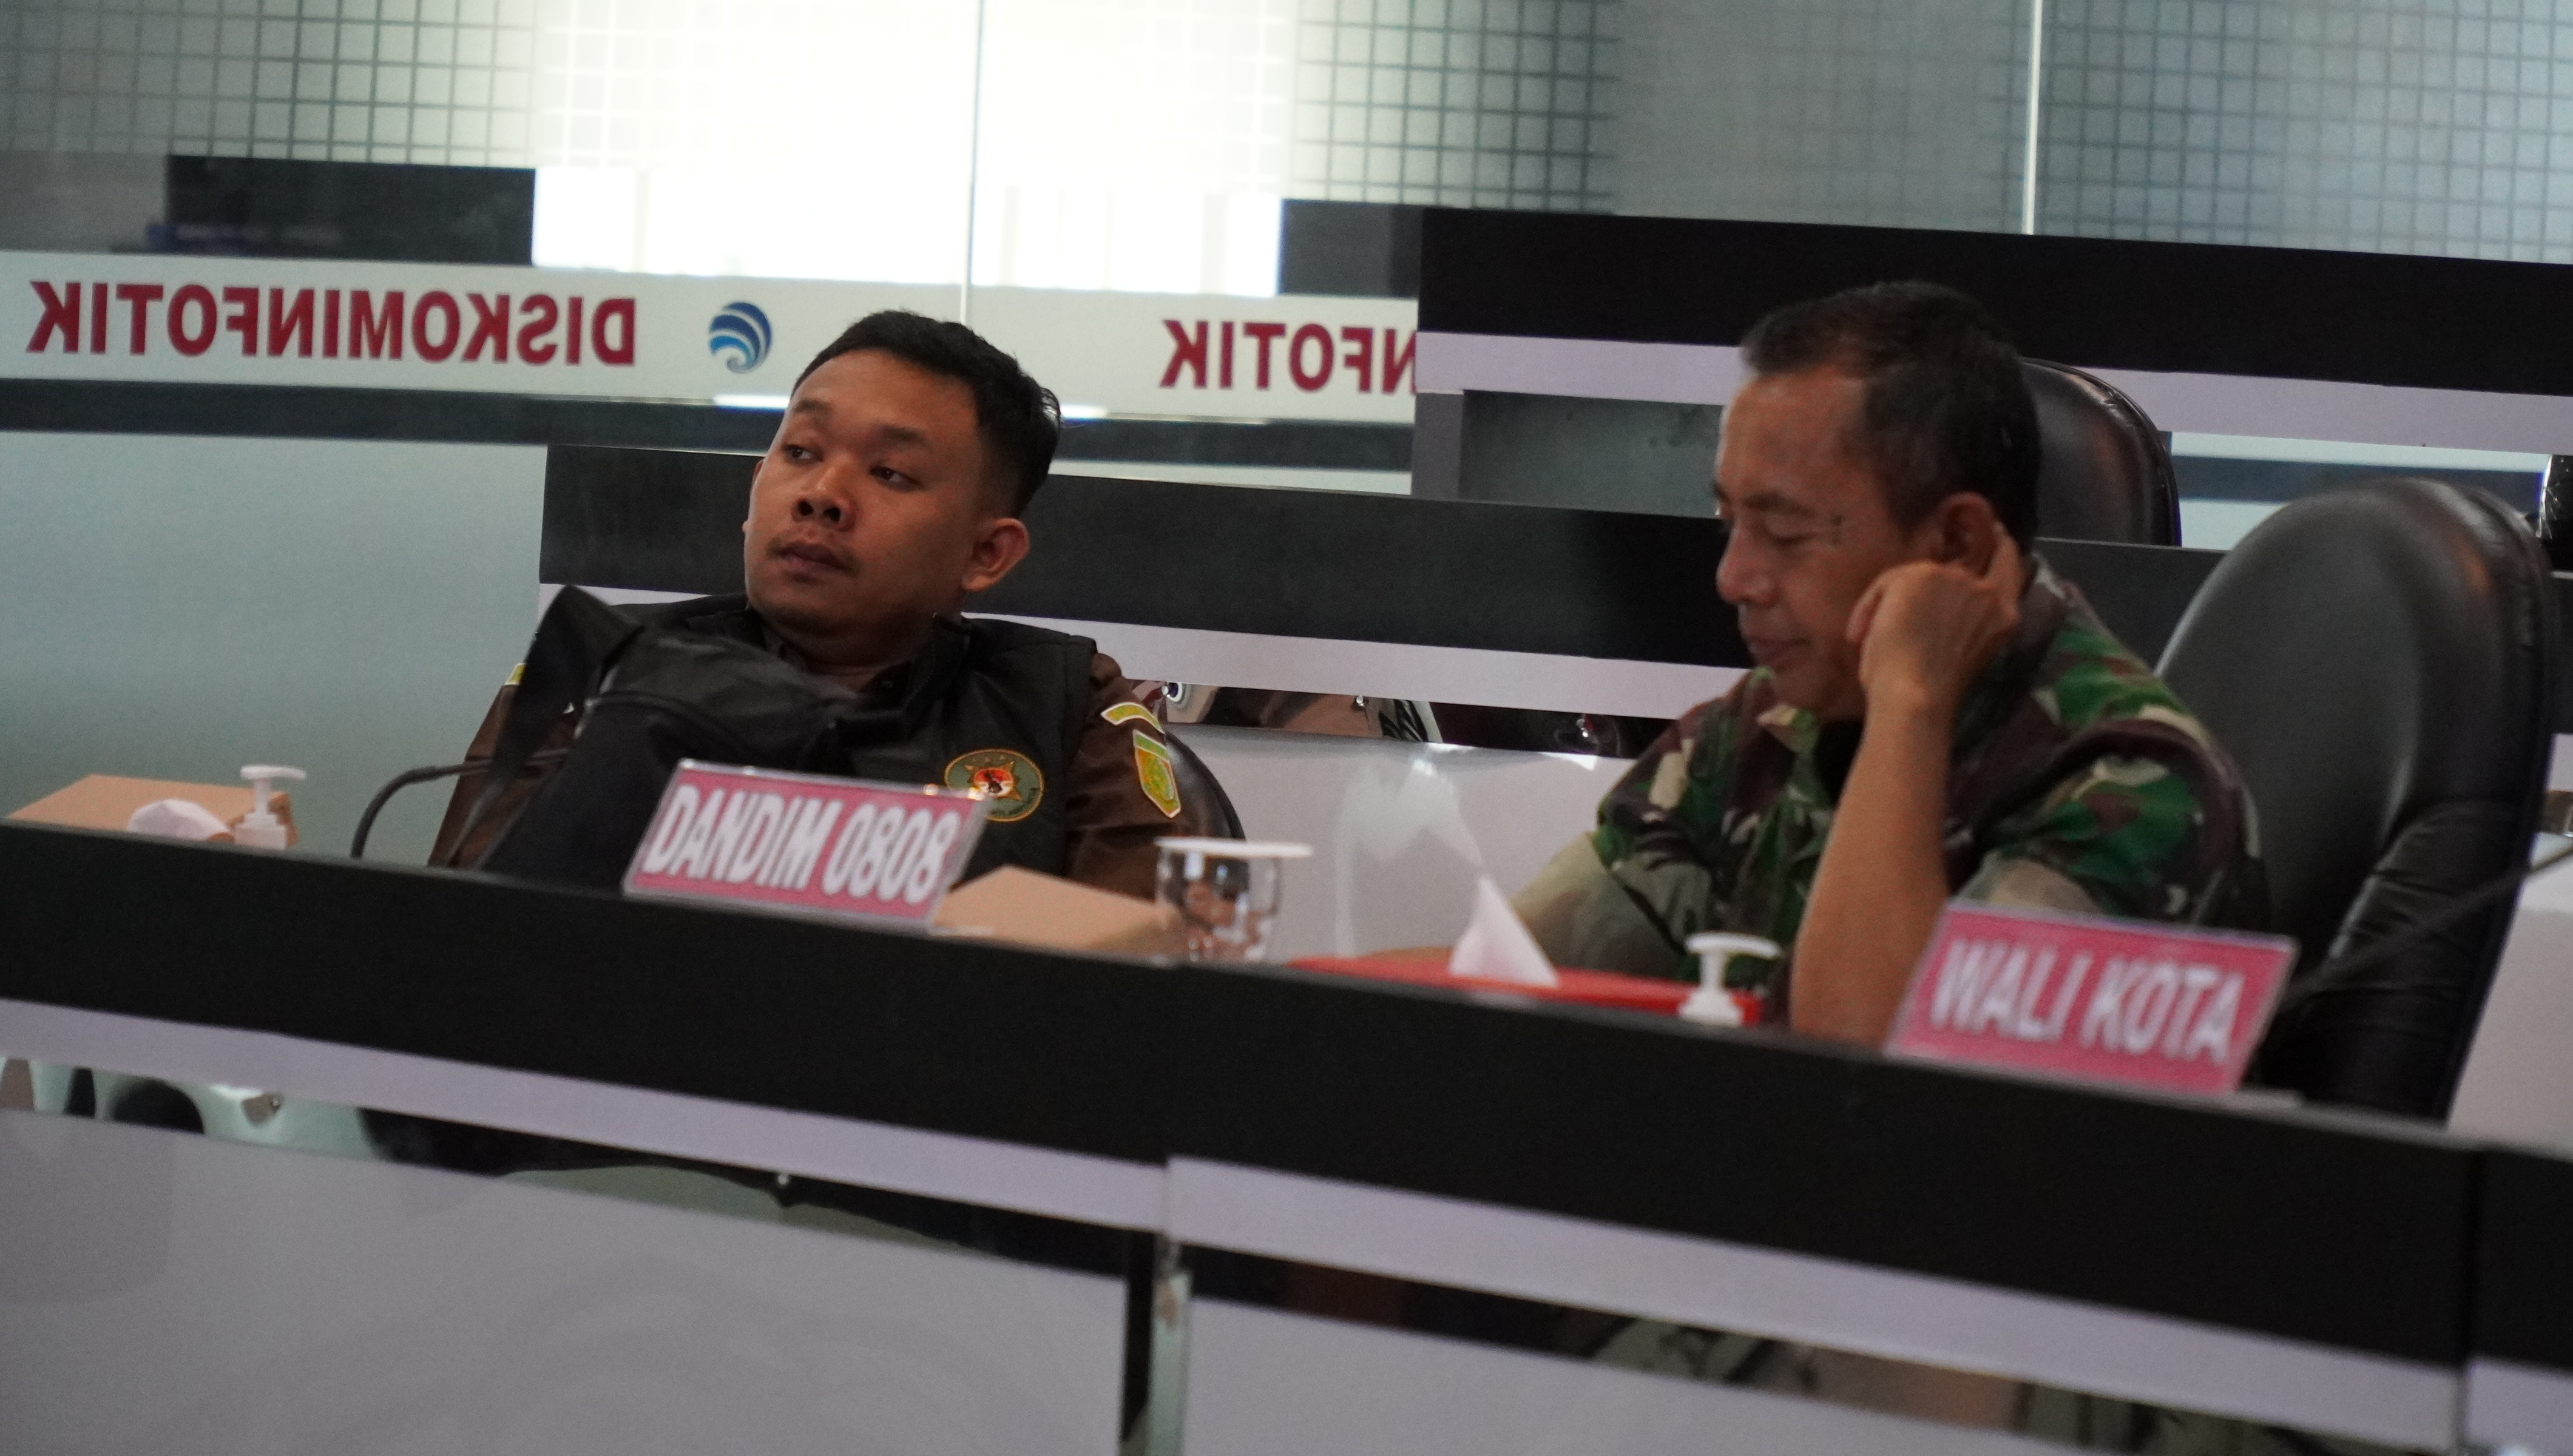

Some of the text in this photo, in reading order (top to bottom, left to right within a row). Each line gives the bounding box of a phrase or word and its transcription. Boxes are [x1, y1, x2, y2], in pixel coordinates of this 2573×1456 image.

[641, 784, 961, 906] DANDIM 0808
[1930, 939, 2244, 1065] WALI KOTA
